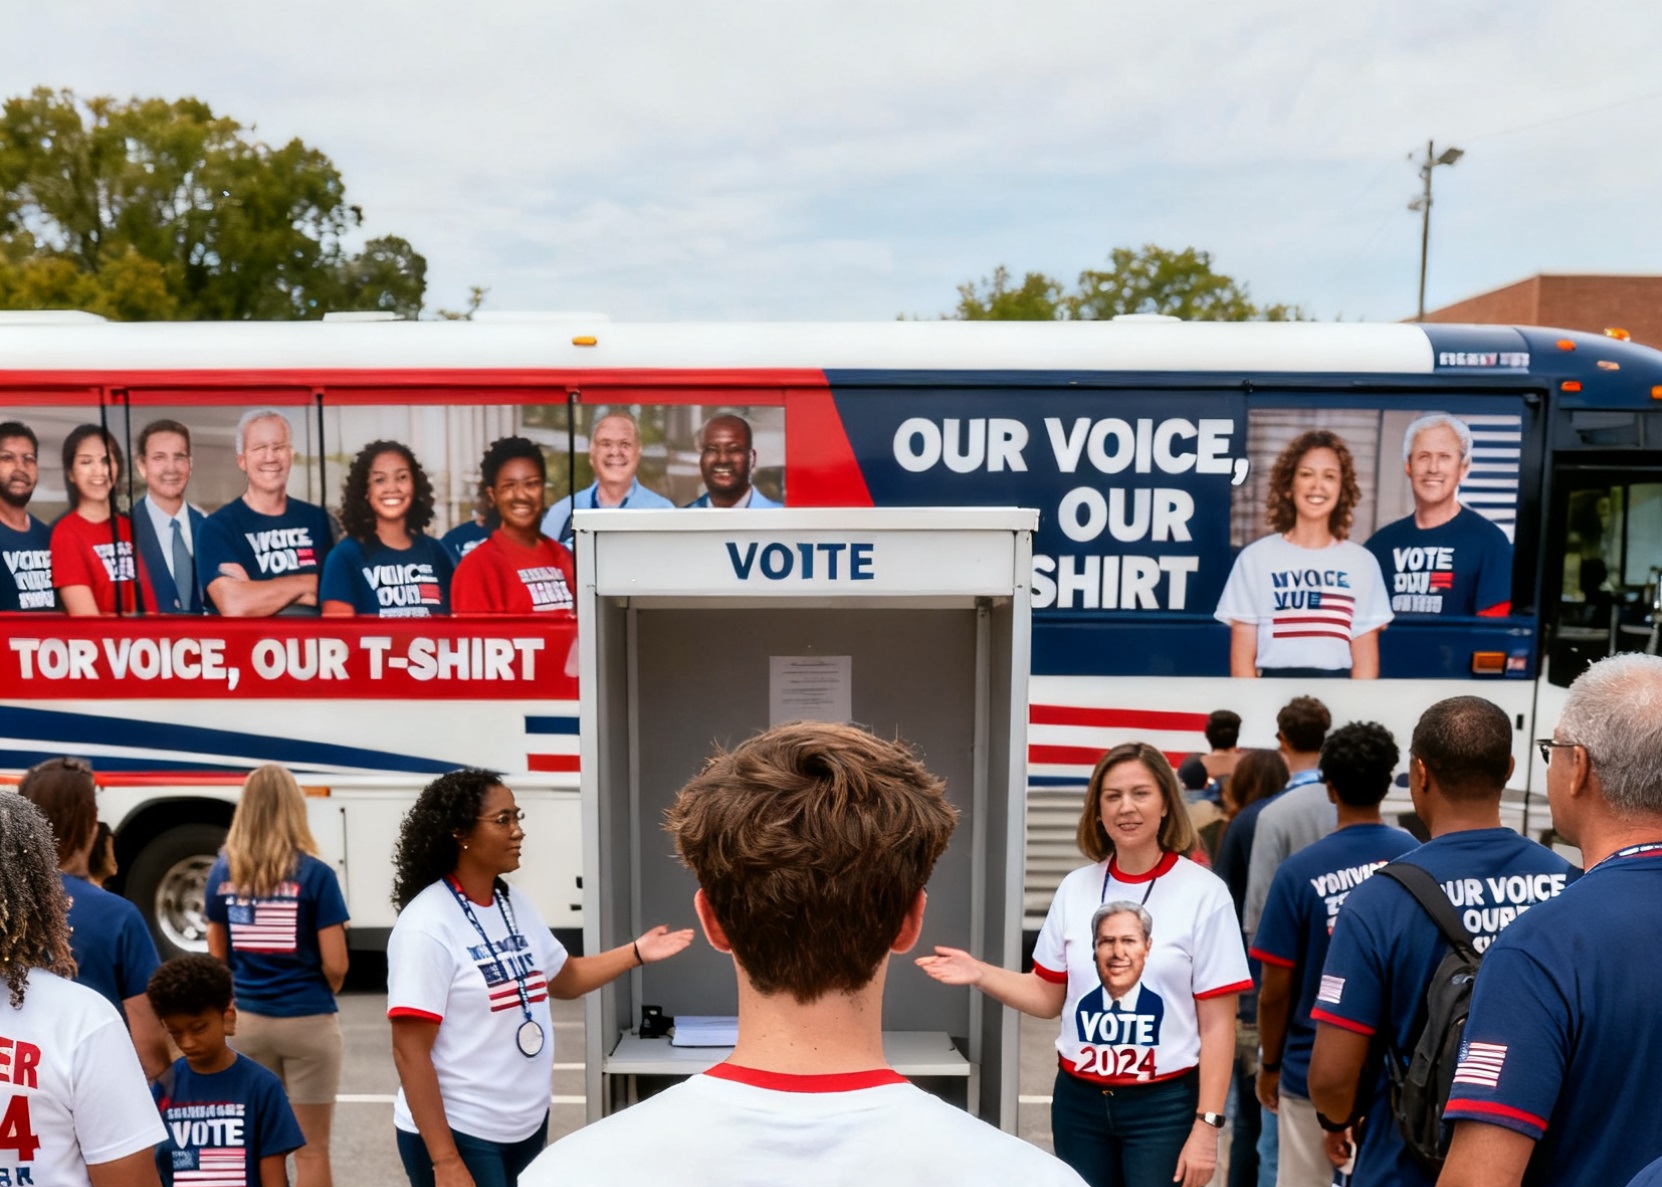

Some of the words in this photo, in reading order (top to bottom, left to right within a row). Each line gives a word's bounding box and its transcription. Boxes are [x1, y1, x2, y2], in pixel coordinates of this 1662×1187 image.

[893, 417, 1029, 473] OUR
[1044, 417, 1250, 486] VOICE,
[1058, 486, 1195, 543] OUR
[1393, 546, 1455, 573] VOTE
[1032, 555, 1199, 610] SHIRT
[9, 637, 99, 680] TOR
[102, 638, 240, 691] VOICE,
[252, 638, 350, 681] OUR
[360, 636, 545, 681] T-SHIRT
[1440, 878, 1485, 907] UR
[1486, 873, 1567, 904] VOICE
[1081, 1010, 1156, 1043] VOTE
[1075, 1045, 1157, 1081] 2024
[0, 1095, 41, 1162] 4
[169, 1118, 245, 1149] VOTE
